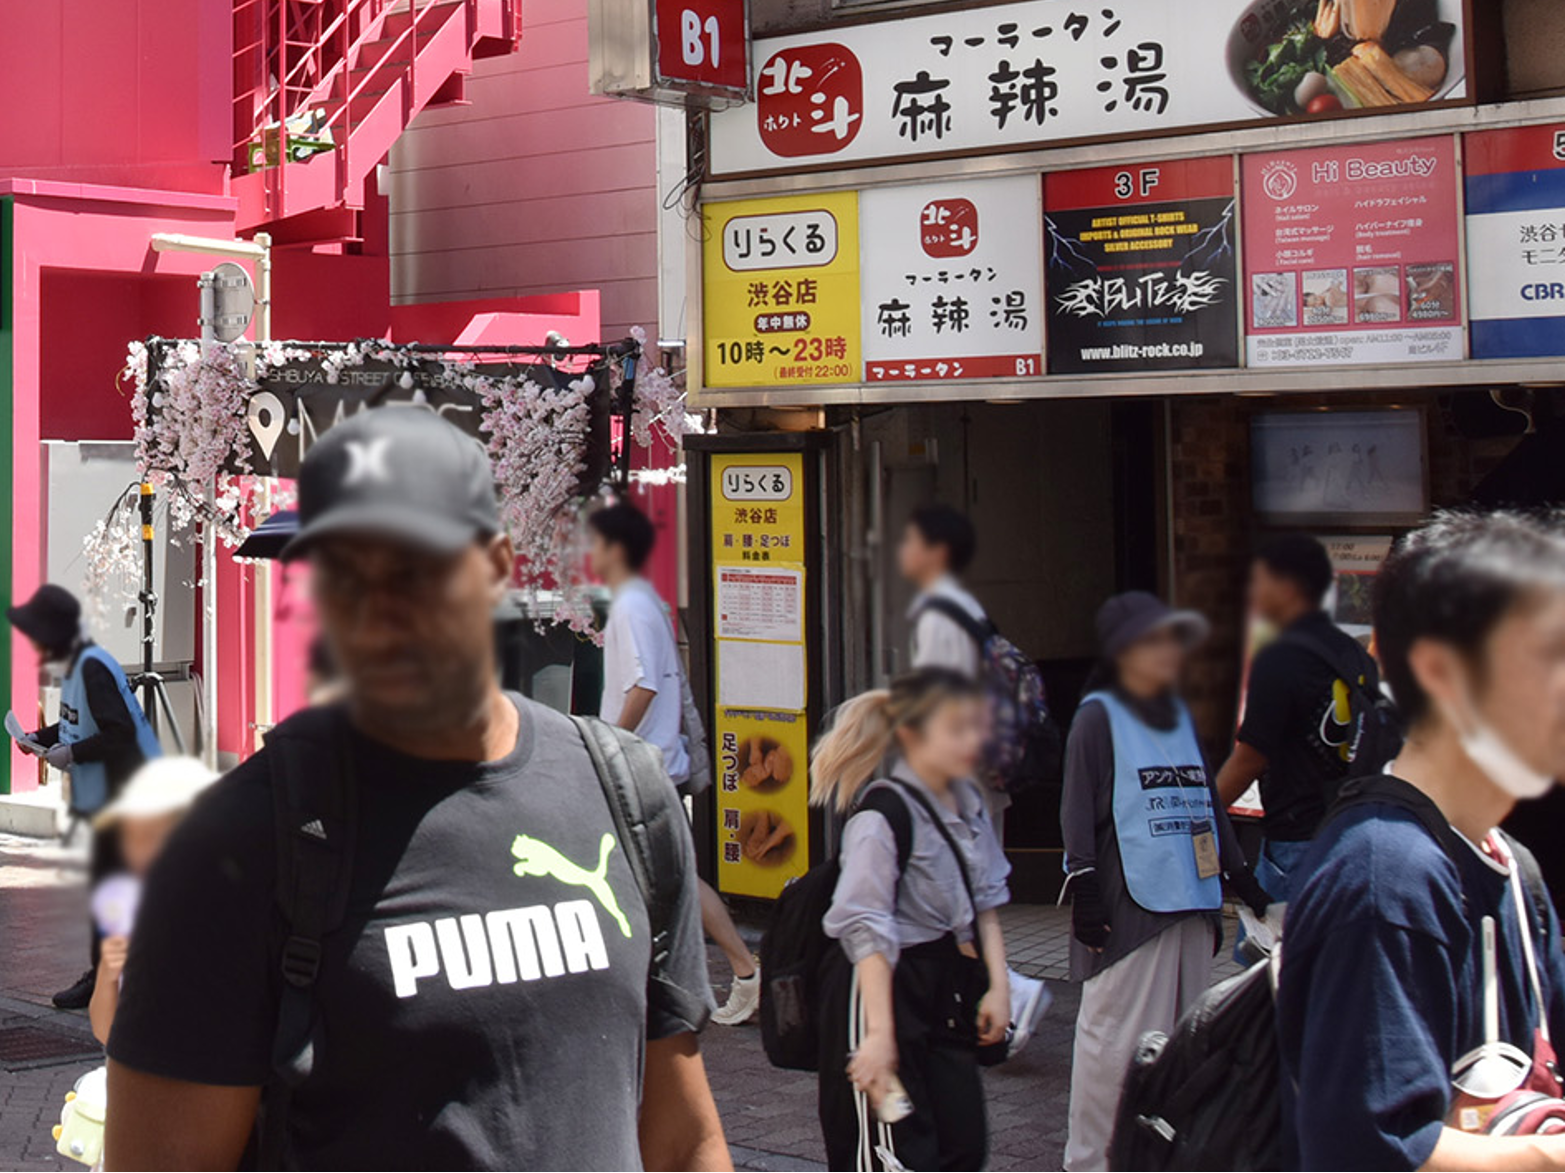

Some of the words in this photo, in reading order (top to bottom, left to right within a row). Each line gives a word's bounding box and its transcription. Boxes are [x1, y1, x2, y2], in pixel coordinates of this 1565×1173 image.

[681, 9, 721, 69] B1
[930, 9, 1122, 57] マーラータン
[891, 42, 1170, 142] 麻辣湯
[764, 112, 802, 132] ホクト
[1312, 160, 1339, 184] Hi
[1346, 155, 1437, 181] Beauty
[734, 223, 826, 259] りらくる
[1519, 223, 1565, 244] 渋谷
[905, 267, 997, 286] マーラータン
[747, 278, 818, 308] 渋谷店
[757, 314, 808, 331] 年中無休
[877, 290, 1029, 339] 麻辣湯
[1080, 341, 1203, 361] www.blitz-rock.co.jp
[269, 369, 323, 384] SHIBUYA
[872, 361, 963, 379] マーラータン
[1015, 358, 1035, 375] B1
[728, 474, 785, 493] りらくる
[734, 508, 778, 524] 渋谷店
[722, 732, 739, 792] 足つぼ
[384, 900, 610, 998] PUMA
